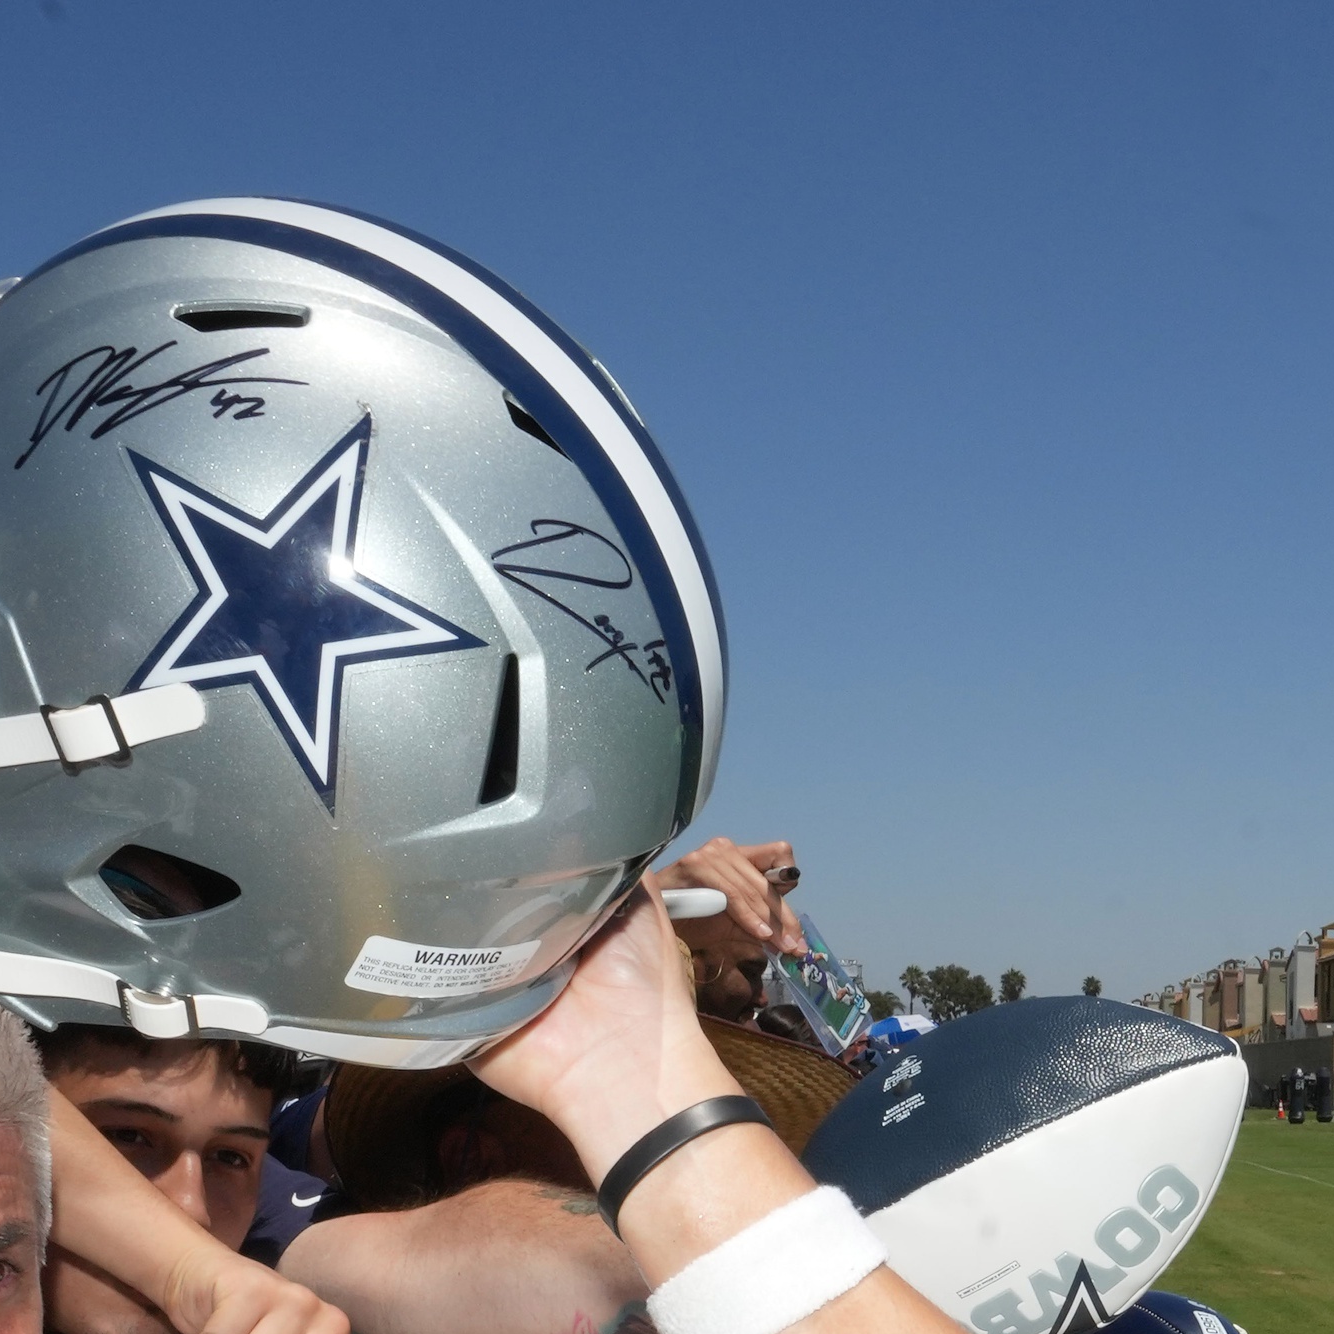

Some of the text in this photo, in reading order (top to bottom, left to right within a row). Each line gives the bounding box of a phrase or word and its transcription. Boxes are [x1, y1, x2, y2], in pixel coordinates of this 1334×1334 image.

[364, 956, 381, 965] THIS
[382, 961, 413, 972] REPLICA
[415, 966, 443, 974] HELMET
[414, 950, 502, 966] WARNING
[354, 971, 398, 985] PROTECTIVE
[359, 964, 375, 972] NOT
[379, 969, 416, 980] DESIGNED
